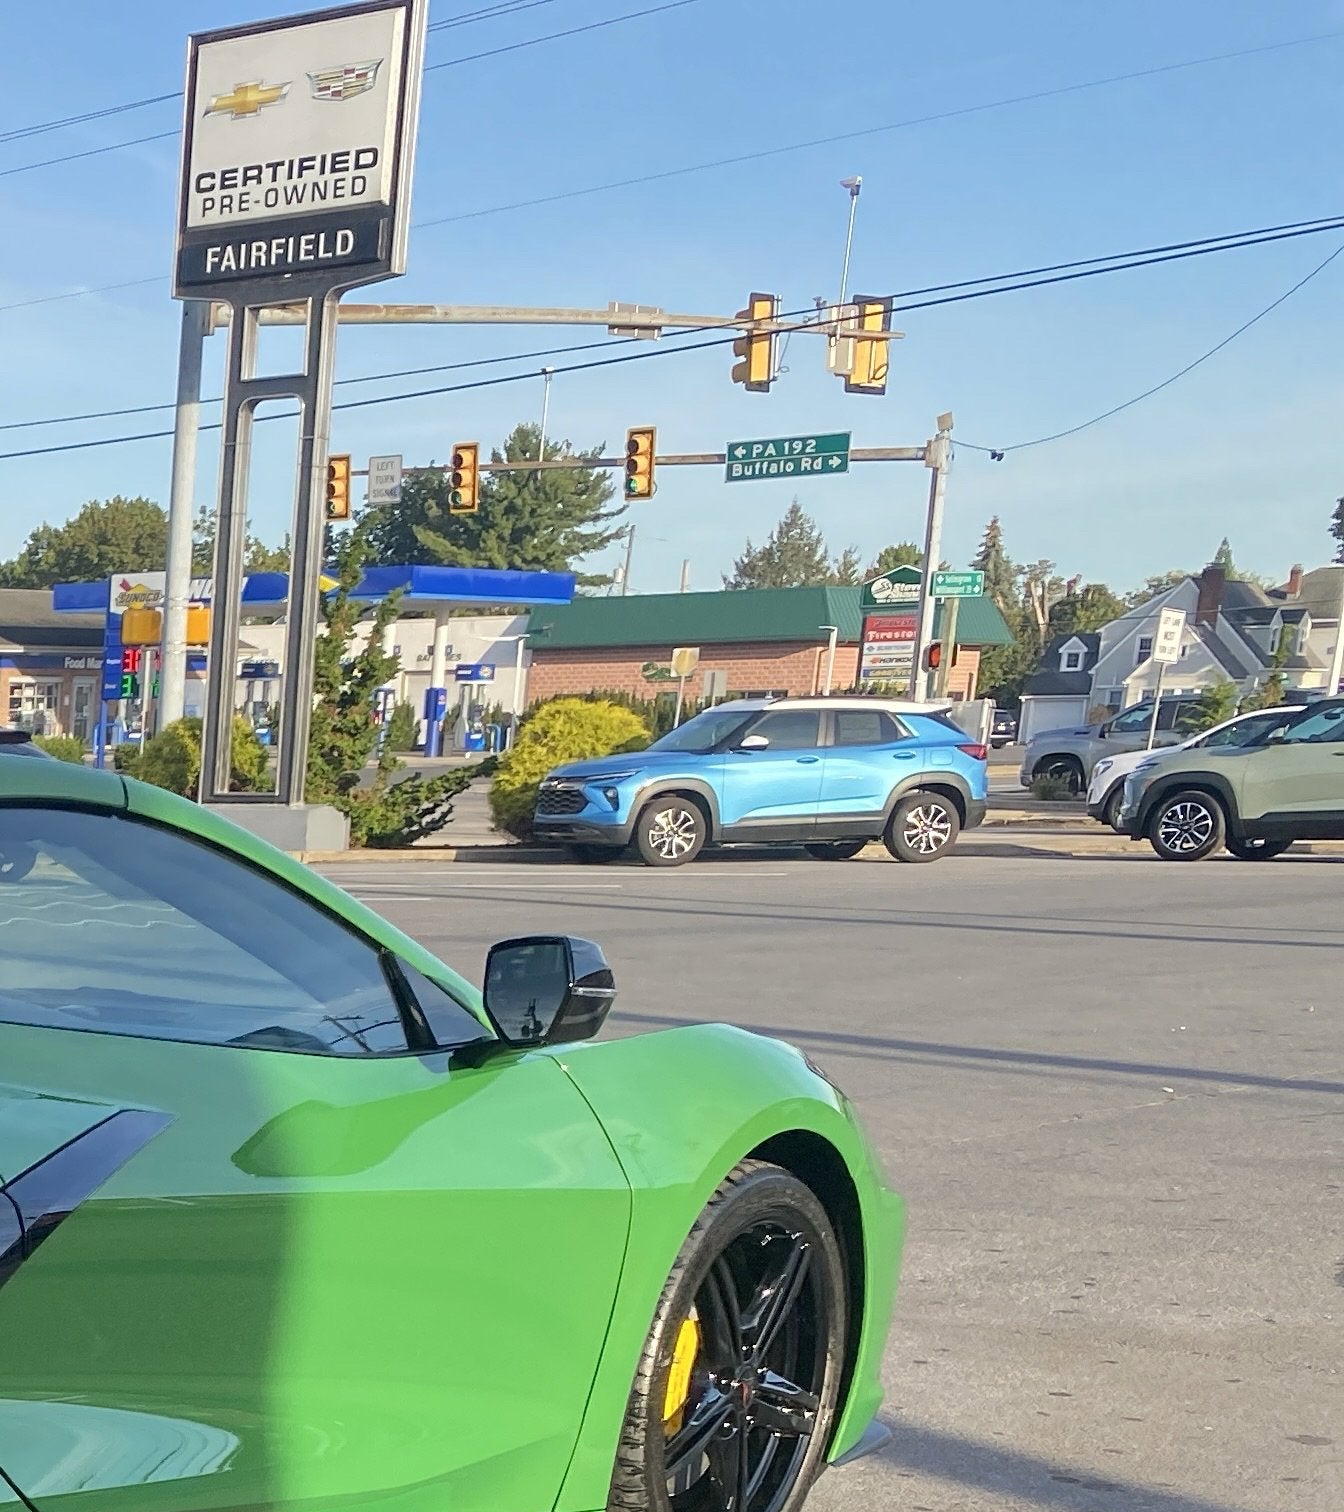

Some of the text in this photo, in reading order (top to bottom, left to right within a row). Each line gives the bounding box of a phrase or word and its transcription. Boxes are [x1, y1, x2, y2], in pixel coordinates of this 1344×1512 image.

[195, 147, 379, 194] CERTIFIED
[201, 175, 368, 218] PRE-OWNED
[205, 228, 355, 273] FAIRFIELD
[752, 439, 817, 458] PA 192
[732, 456, 823, 477] Buffalo Rd
[116, 590, 163, 604] SUNOCO
[64, 656, 86, 669] Food
[86, 657, 103, 669] Mar
